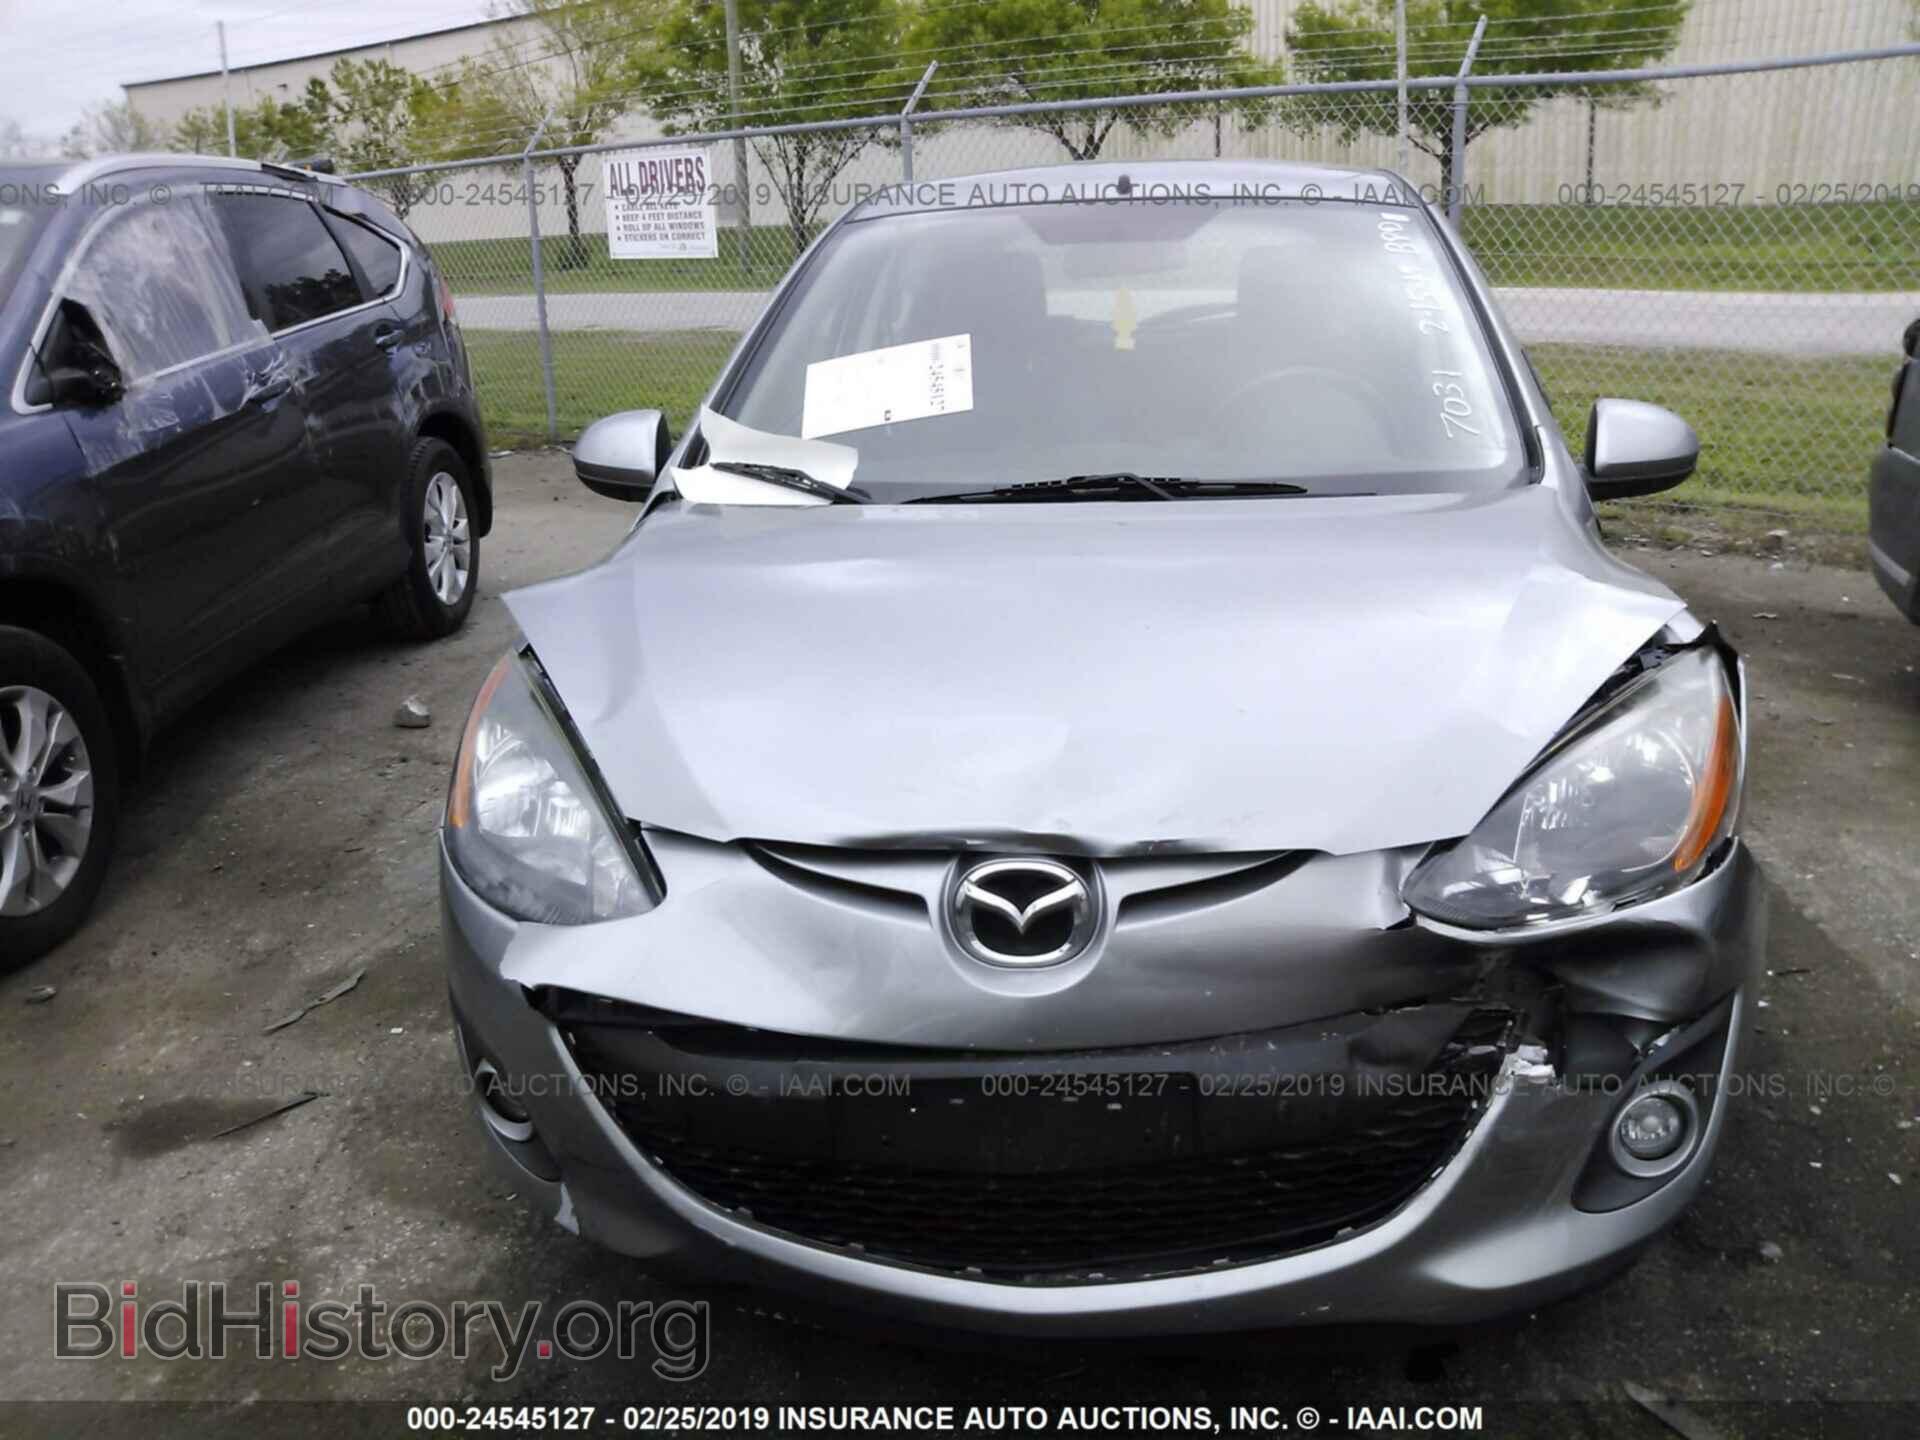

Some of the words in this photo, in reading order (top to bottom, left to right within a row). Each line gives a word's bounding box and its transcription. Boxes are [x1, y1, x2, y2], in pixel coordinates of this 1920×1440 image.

[608, 162, 636, 196] ALL
[638, 156, 706, 195] DRIVERS
[667, 210, 703, 220] DISTANCE
[668, 220, 705, 230] WINDOWS
[1431, 370, 1481, 438] 7031
